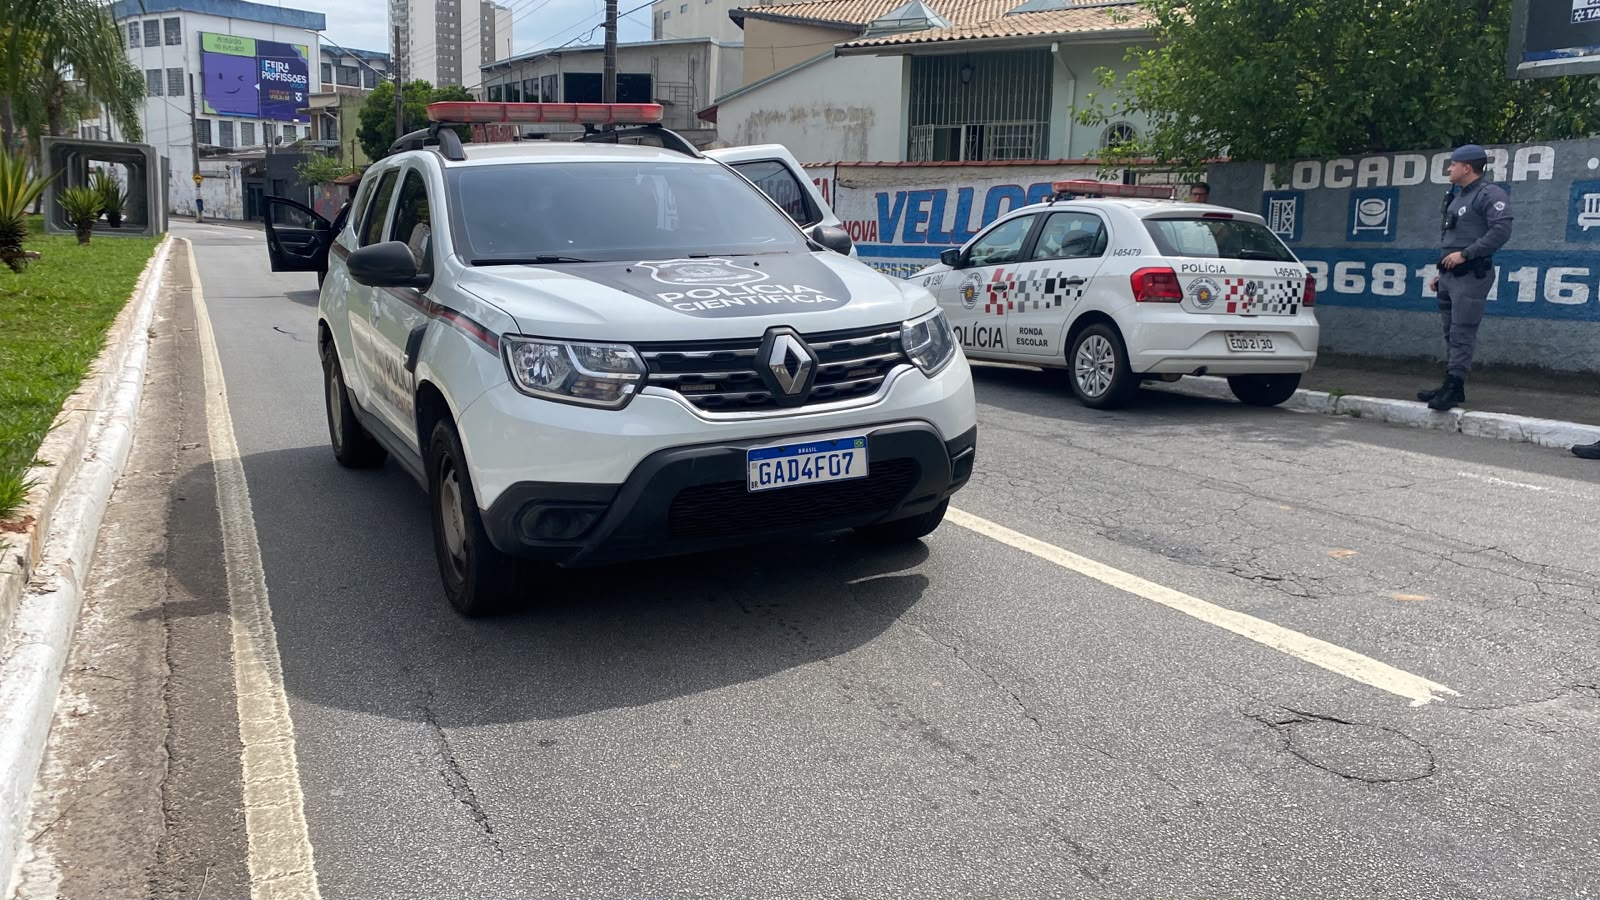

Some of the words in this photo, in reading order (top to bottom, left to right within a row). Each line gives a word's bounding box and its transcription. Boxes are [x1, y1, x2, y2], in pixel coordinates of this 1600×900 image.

[265, 60, 289, 73] FEIRA
[1181, 262, 1227, 274] POLÍCIA
[656, 283, 825, 303] POLÍCIA
[672, 292, 839, 312] CIENTÍFICA
[952, 321, 1005, 349] OLÍCIA
[1018, 326, 1044, 336] RONDA
[1016, 337, 1049, 348] ESCOLAR
[759, 452, 853, 485] GAD4F07
[751, 480, 759, 489] BR
